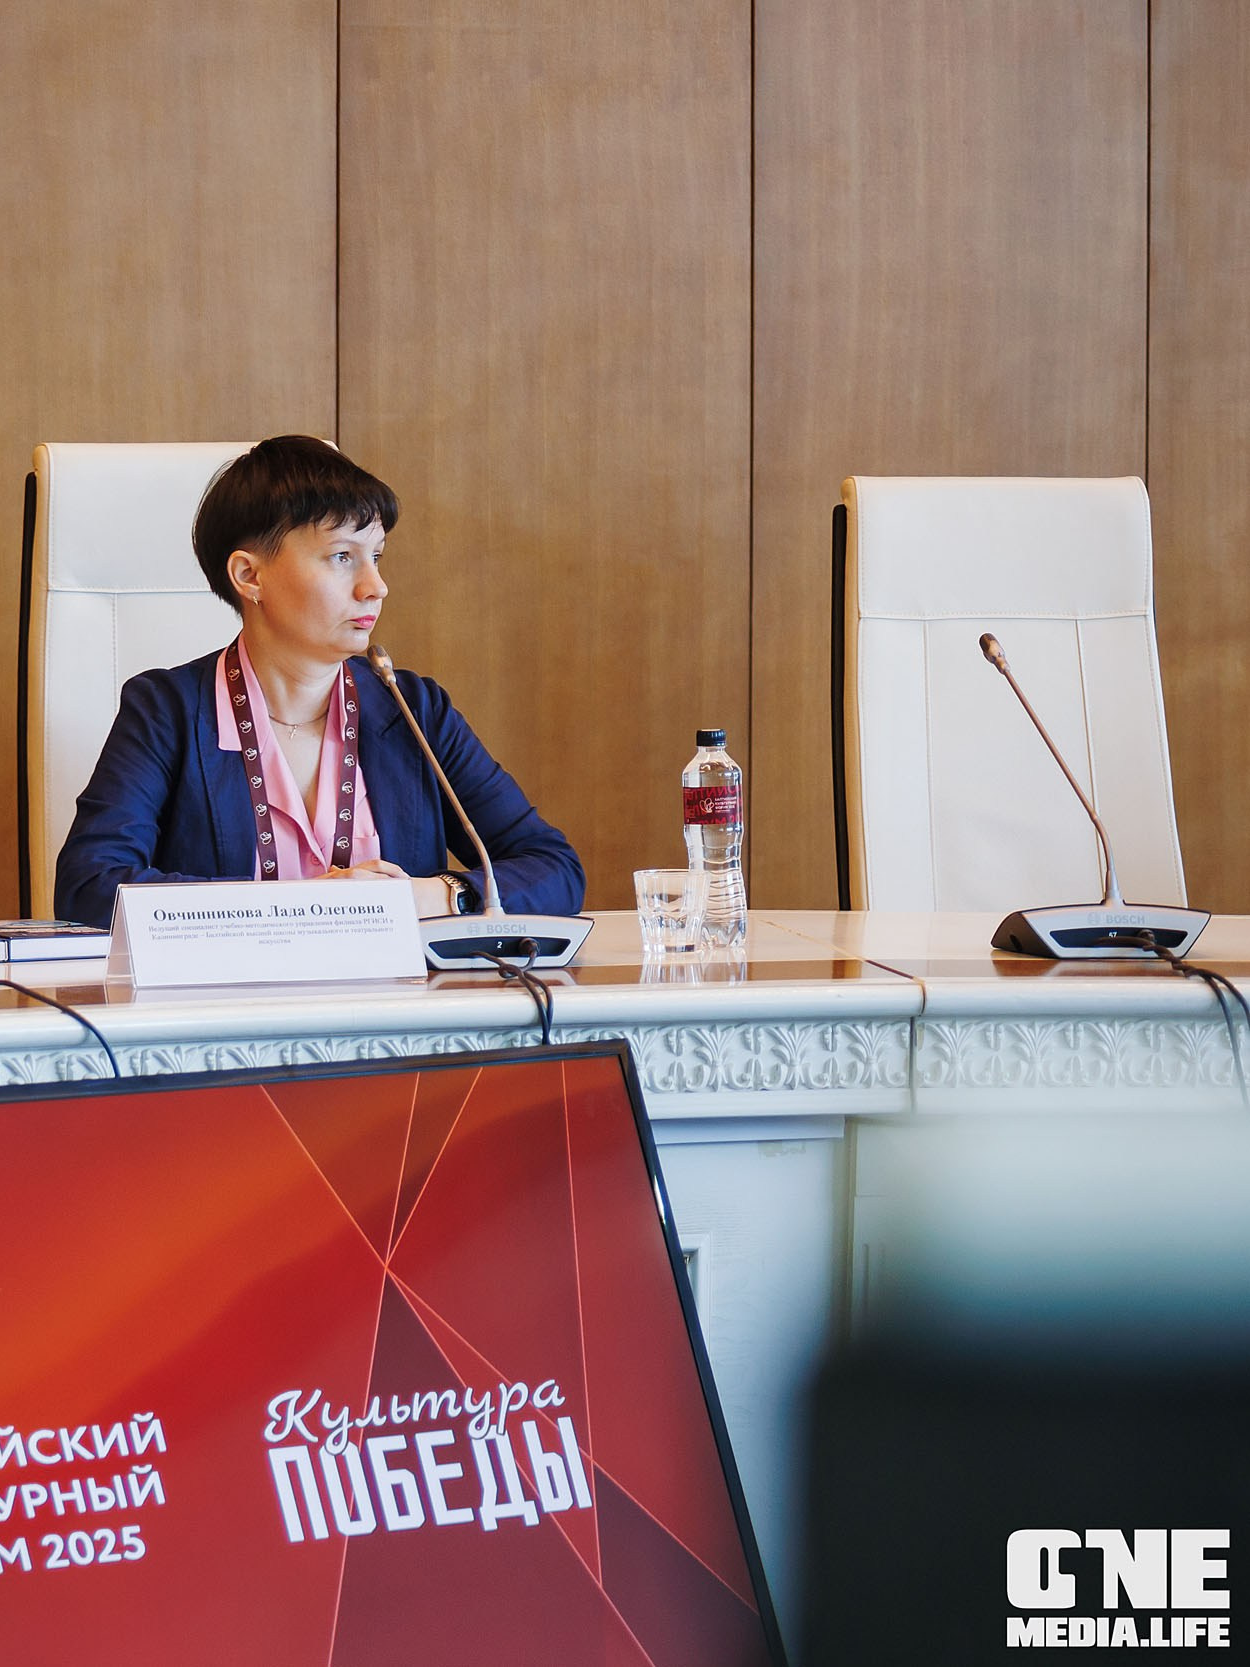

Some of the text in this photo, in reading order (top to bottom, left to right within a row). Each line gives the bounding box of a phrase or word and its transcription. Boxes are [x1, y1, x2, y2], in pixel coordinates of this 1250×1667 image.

[153, 903, 385, 922] Овчинникова Лада Олеговна
[1106, 914, 1146, 925] BOSCH
[486, 923, 527, 934] BOSCH
[496, 941, 503, 949] 2
[263, 1379, 566, 1450] Культура
[268, 1416, 593, 1543] ПОБЕДЫ
[41, 1525, 146, 1569] 2025
